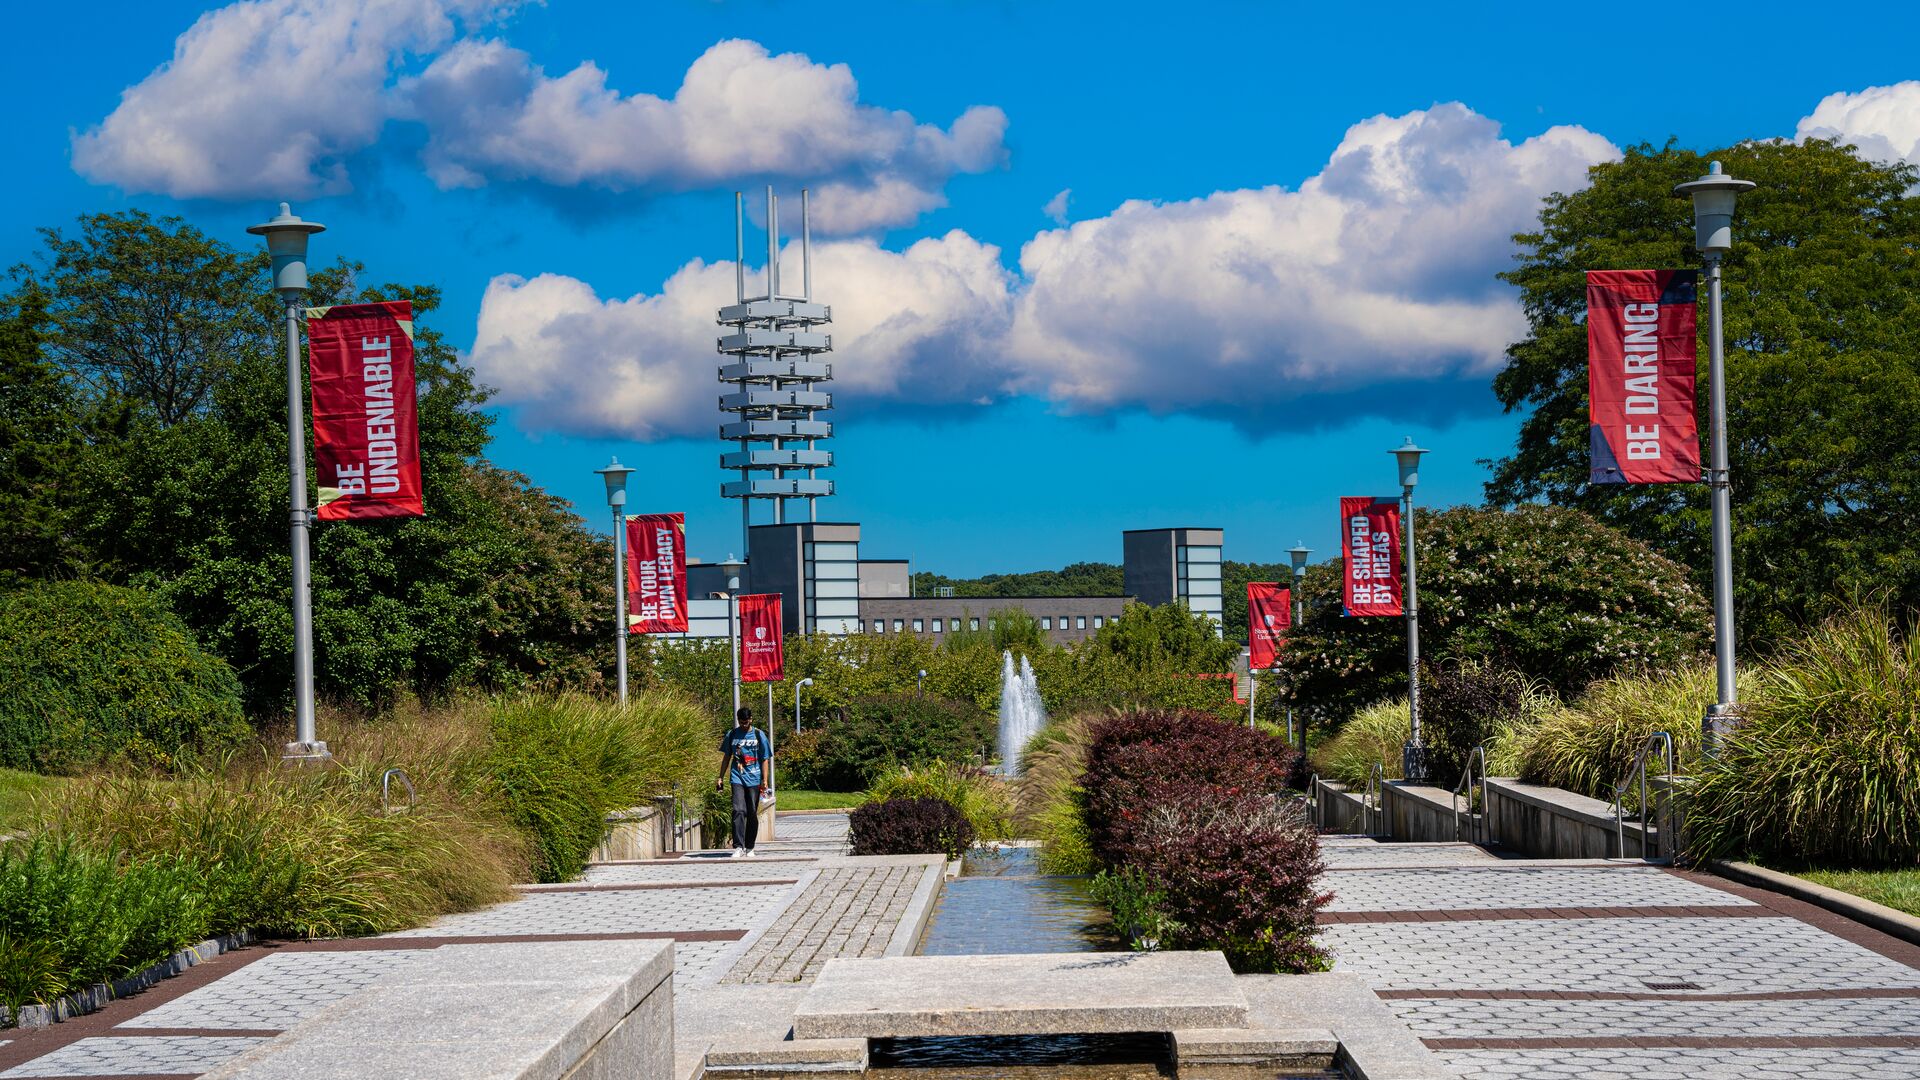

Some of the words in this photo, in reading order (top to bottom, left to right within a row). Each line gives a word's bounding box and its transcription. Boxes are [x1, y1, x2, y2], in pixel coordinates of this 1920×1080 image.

[1623, 303, 1659, 415] DARING
[362, 335, 400, 494] UNDENIABLE
[1626, 424, 1661, 460] BE
[336, 462, 366, 495] BE
[656, 527, 674, 581] LEGACY
[1351, 516, 1371, 580] SHAPED
[1372, 531, 1391, 578] IDEAS
[640, 559, 658, 602] YOUR
[1353, 583, 1371, 604] BE
[1373, 583, 1392, 604] BY
[641, 601, 658, 620] BE
[659, 584, 676, 620] OWN
